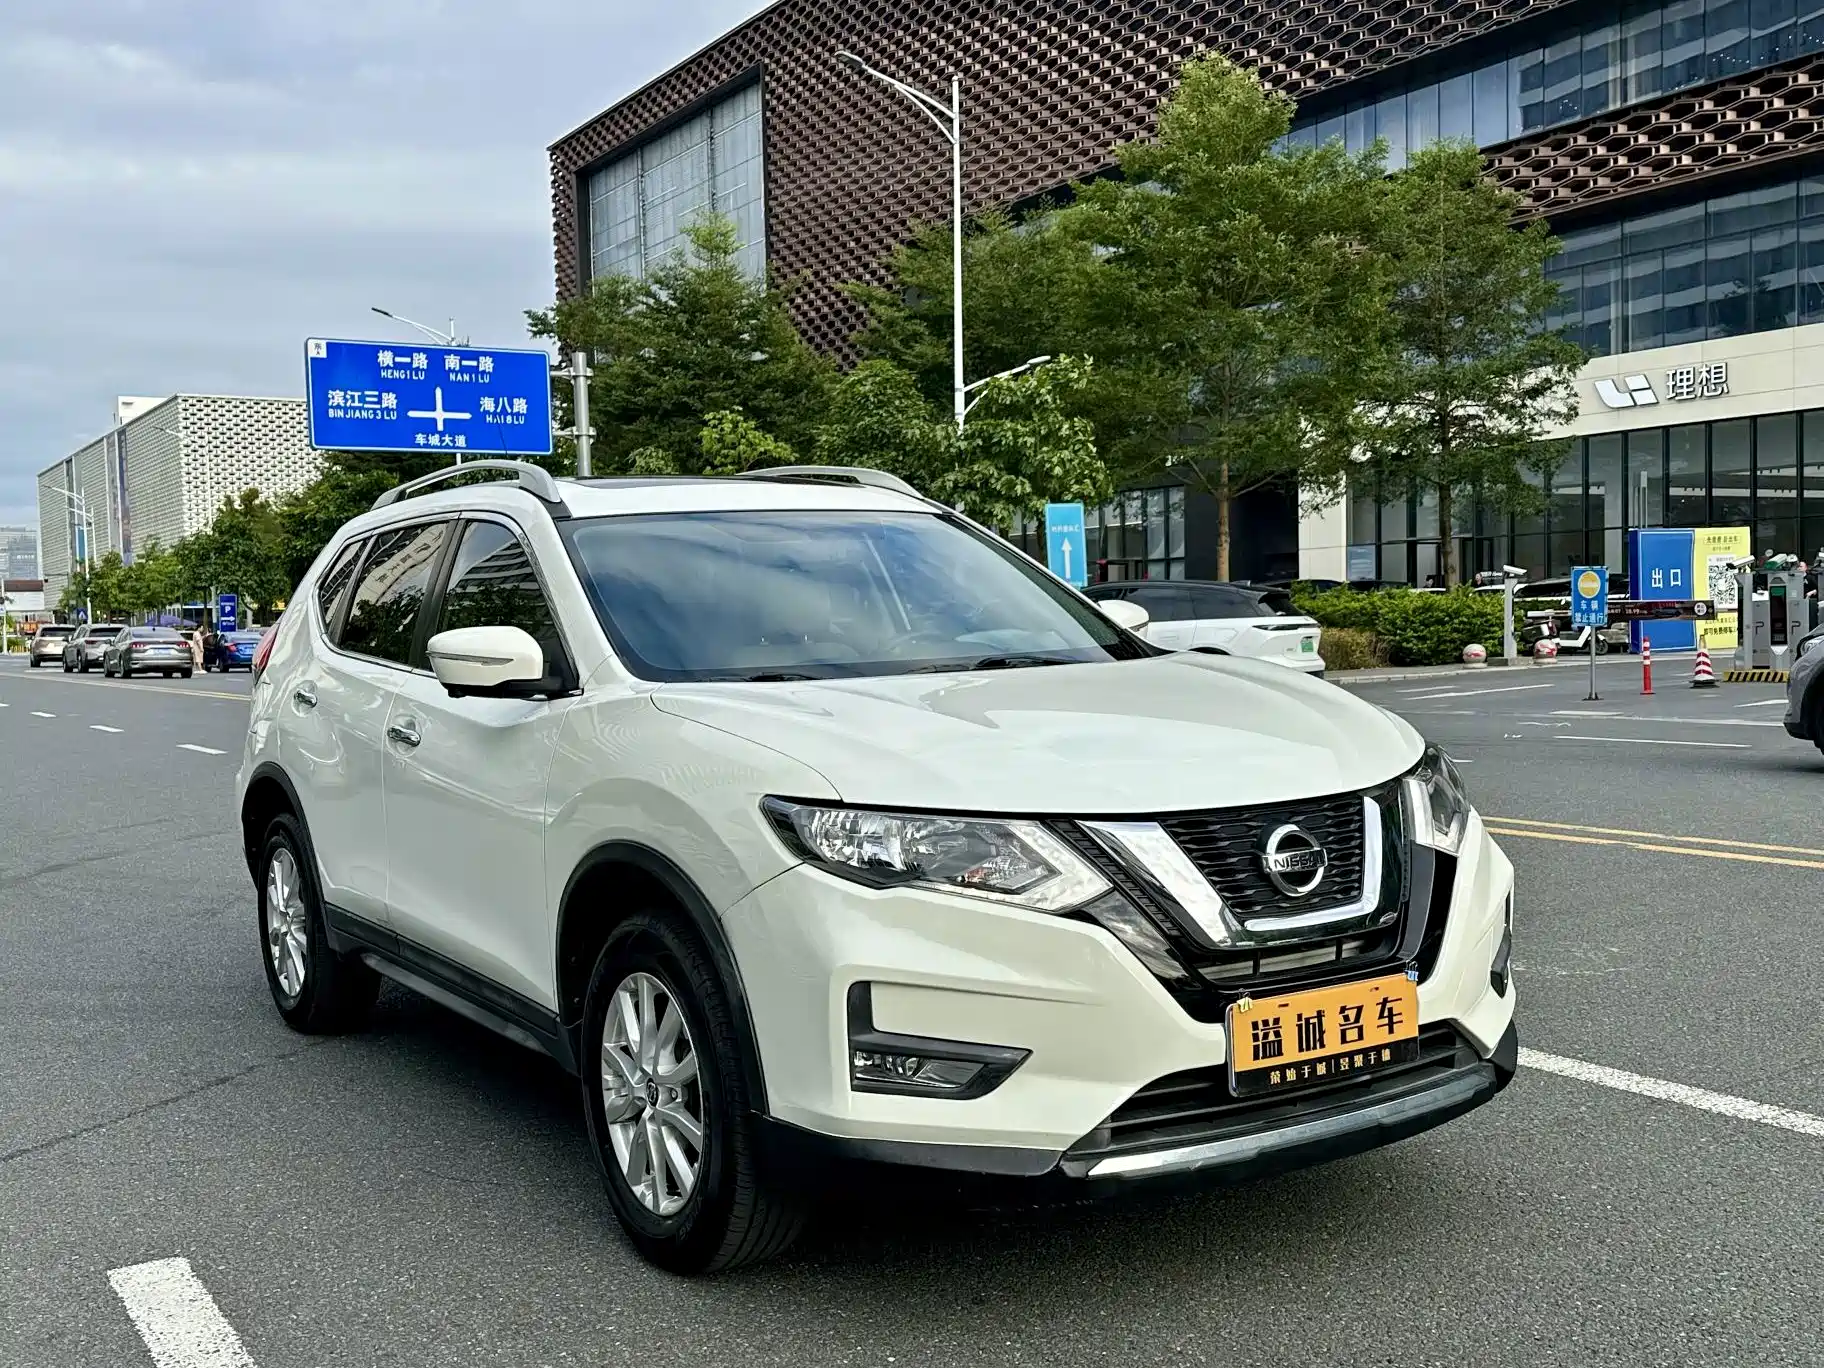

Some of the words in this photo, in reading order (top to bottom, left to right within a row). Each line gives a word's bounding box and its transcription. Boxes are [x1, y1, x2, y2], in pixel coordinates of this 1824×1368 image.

[377, 350, 428, 369] 横一路
[444, 354, 494, 372] 南一路
[478, 374, 490, 383] LU
[1665, 361, 1729, 401] 理想
[328, 390, 397, 409] 滨江三路
[480, 396, 528, 414] 海八路
[414, 433, 467, 448] 车城大道
[1651, 567, 1681, 589] 出口
[1580, 600, 1598, 611] 车辆
[1575, 612, 1604, 624] 禁止通行
[1251, 996, 1404, 1061] 溢诚名车
